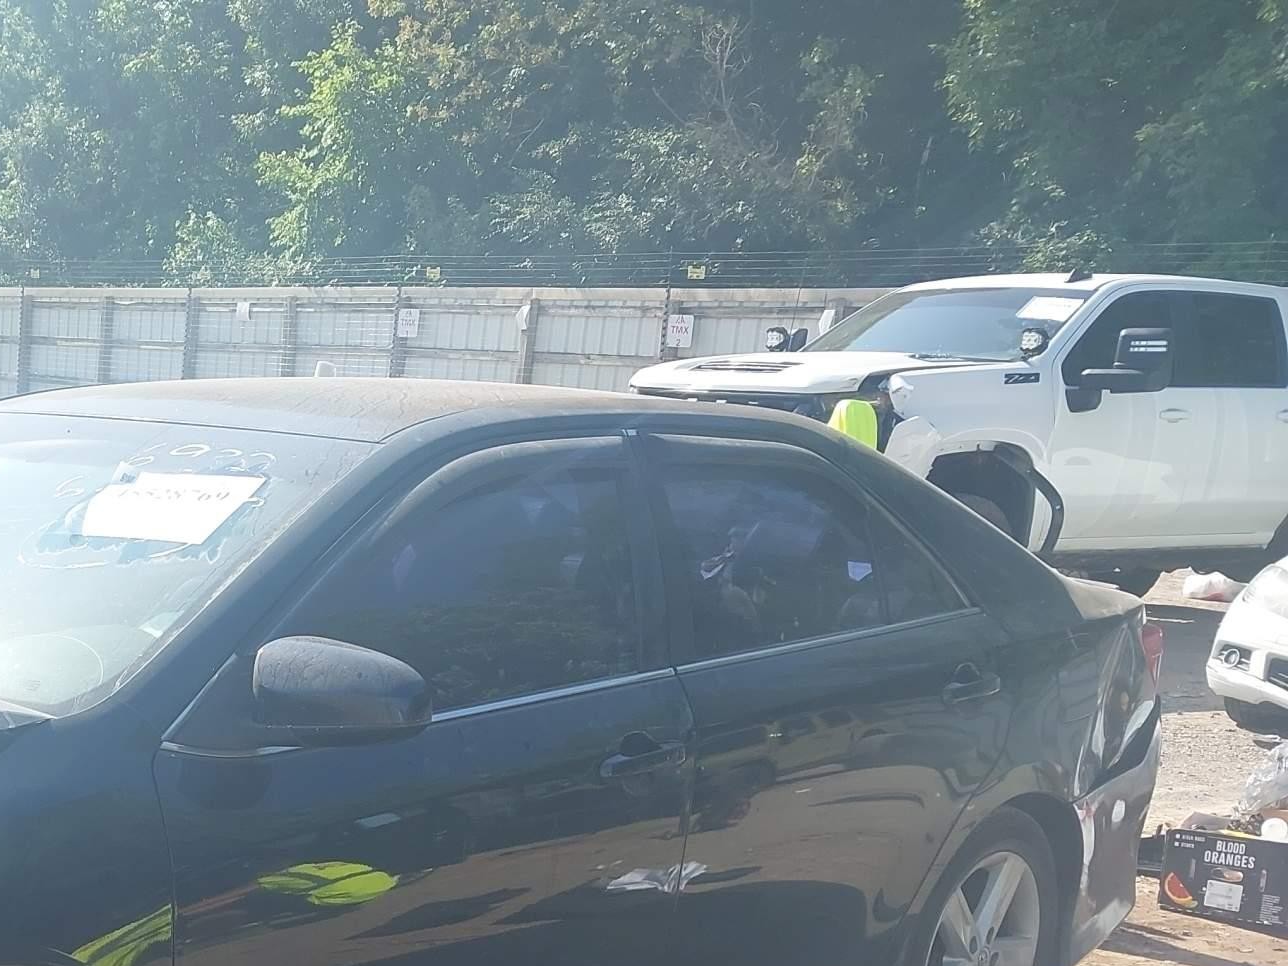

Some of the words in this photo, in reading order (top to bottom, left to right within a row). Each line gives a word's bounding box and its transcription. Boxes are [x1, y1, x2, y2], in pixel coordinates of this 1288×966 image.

[670, 325, 689, 335] TMX
[1216, 840, 1246, 854] BLOOD
[1204, 851, 1255, 868] ORANGES
